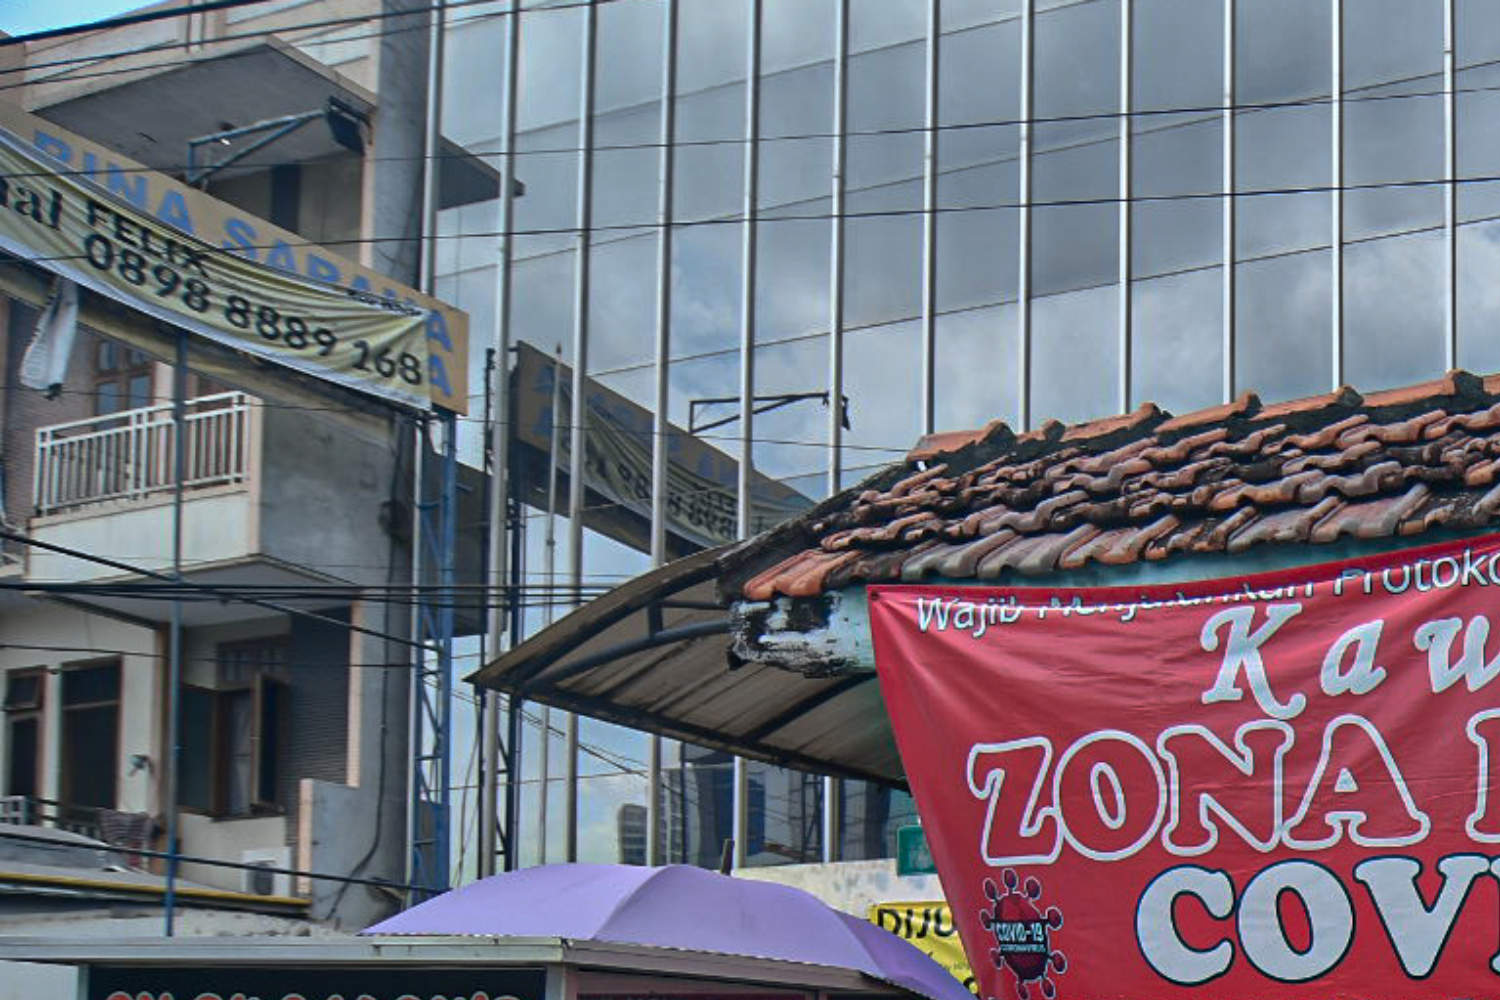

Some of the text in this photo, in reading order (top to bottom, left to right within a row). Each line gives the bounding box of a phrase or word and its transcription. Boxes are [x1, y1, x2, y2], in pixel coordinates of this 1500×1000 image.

[86, 233, 210, 313] 0898
[225, 295, 337, 357] 8889
[352, 340, 423, 386] 168
[917, 596, 1023, 638] Wajib
[967, 713, 1430, 867] ZONA
